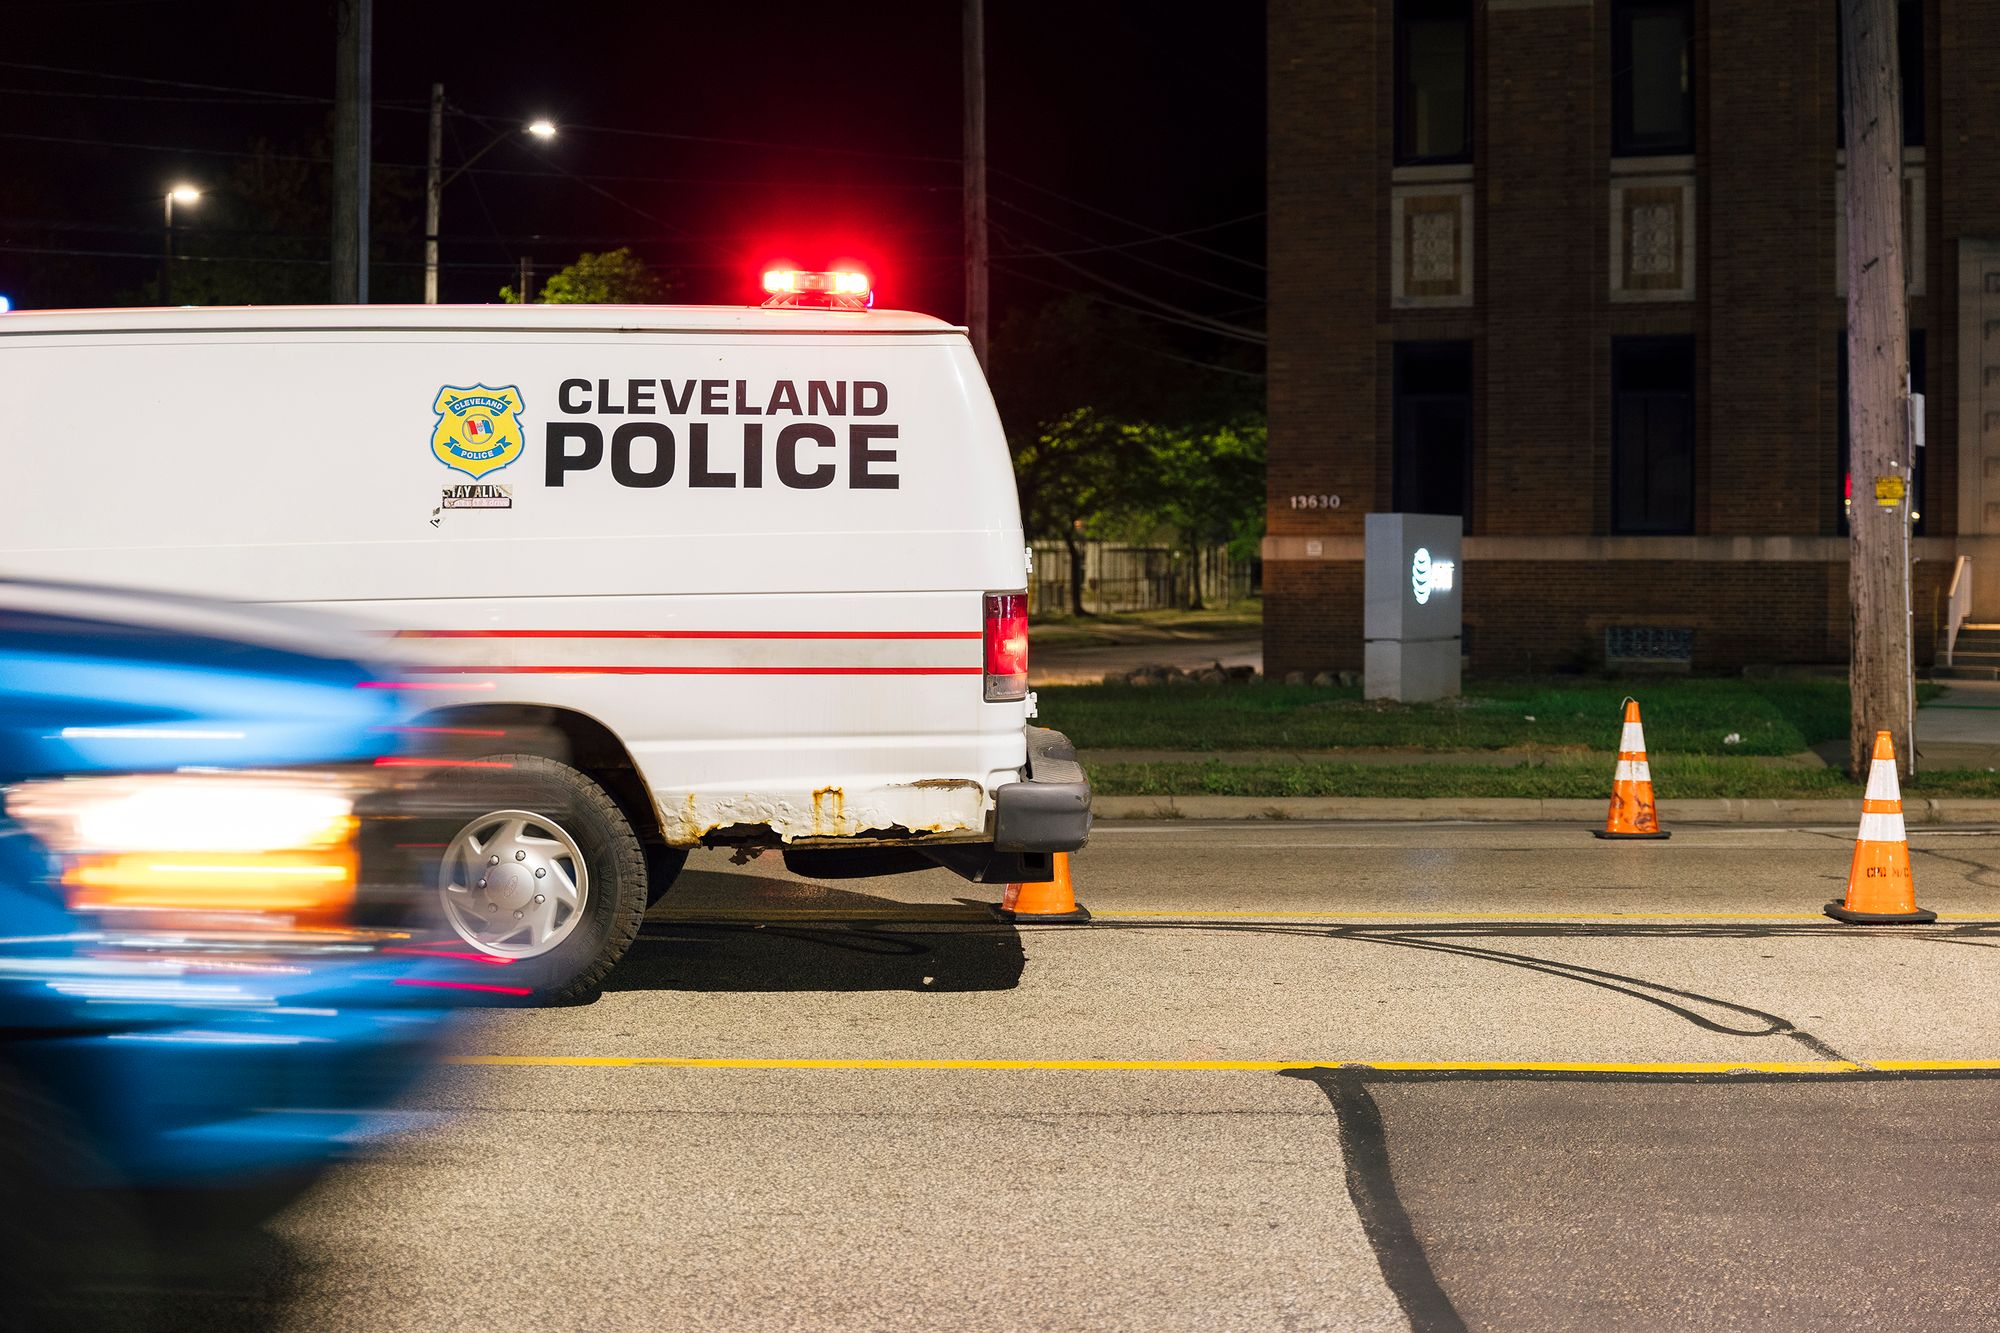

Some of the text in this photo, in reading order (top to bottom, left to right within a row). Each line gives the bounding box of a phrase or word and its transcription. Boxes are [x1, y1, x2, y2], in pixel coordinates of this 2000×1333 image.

[558, 378, 888, 416] CLEVELAND
[454, 398, 503, 411] CLEVELAND
[460, 450, 494, 460] POLICE
[545, 421, 900, 490] POLICE
[474, 485, 504, 498] ALIV
[1290, 494, 1341, 510] 13630
